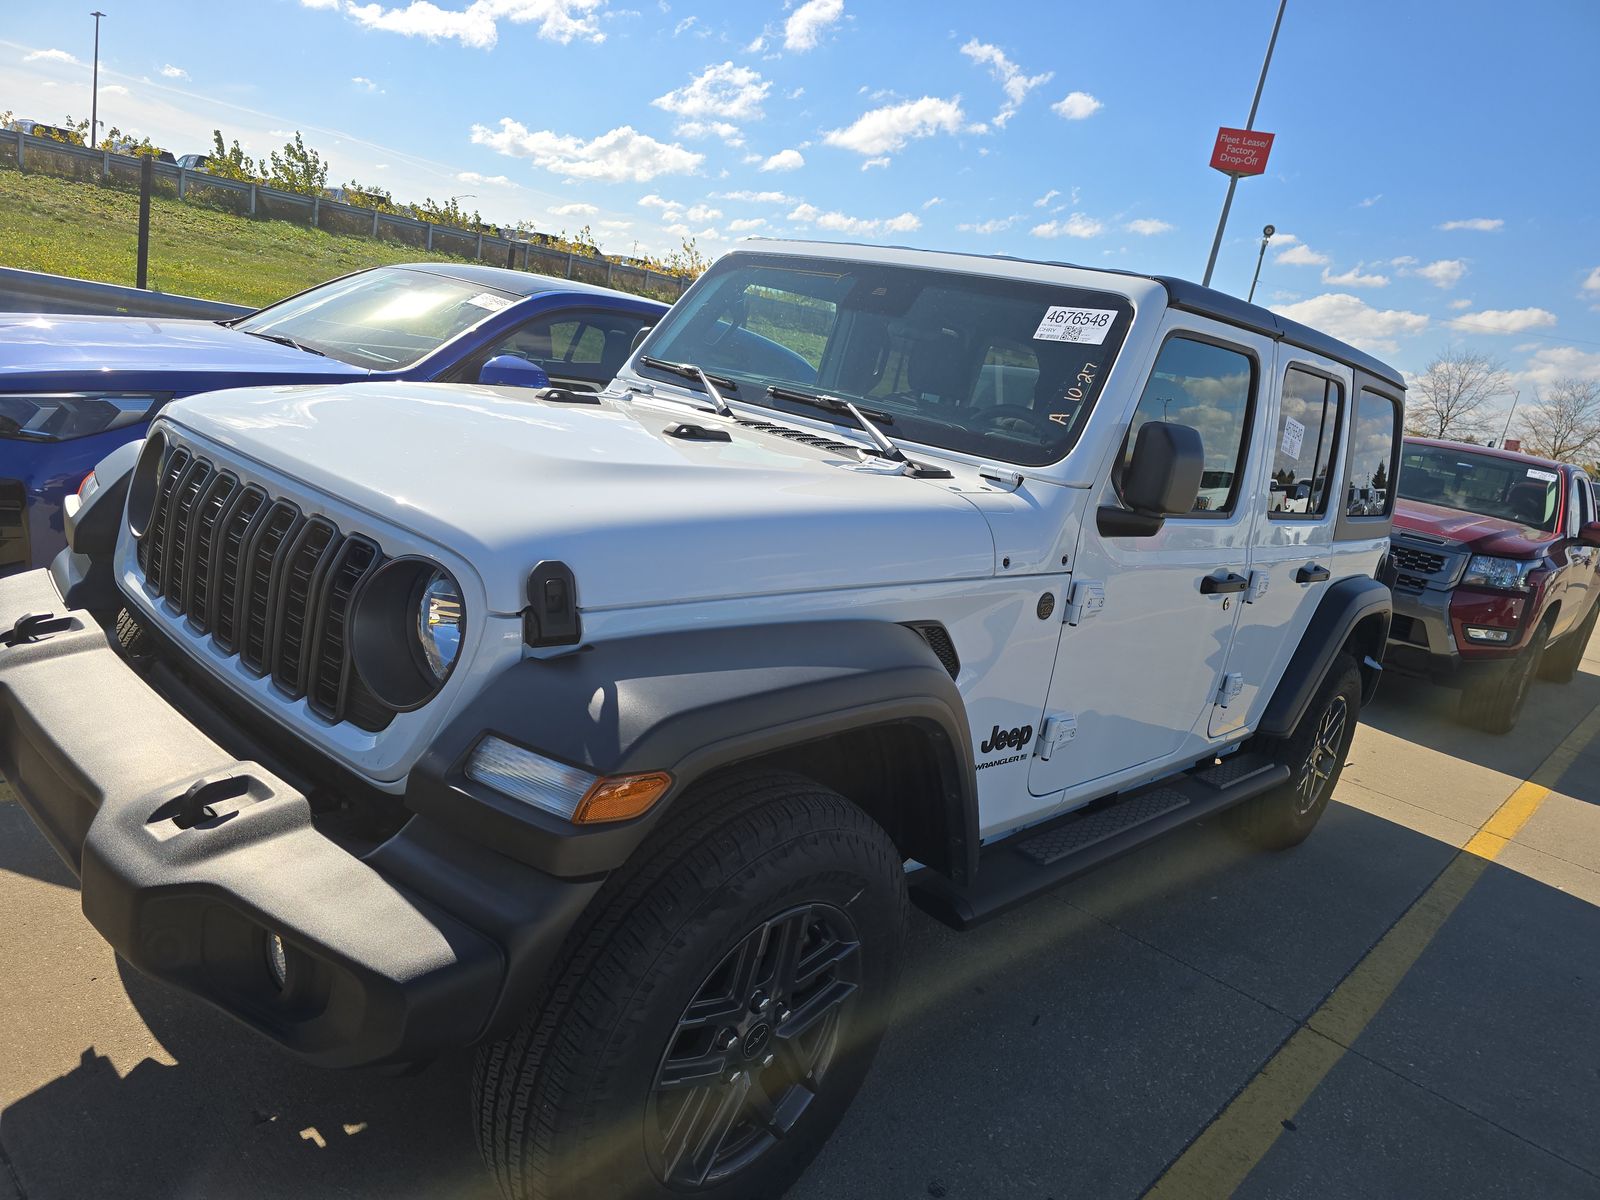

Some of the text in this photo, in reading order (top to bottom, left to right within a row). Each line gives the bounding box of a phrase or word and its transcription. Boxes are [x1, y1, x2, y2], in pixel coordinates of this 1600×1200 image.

[1219, 134, 1269, 148] Fleet Lease/
[1226, 144, 1257, 157] Factory
[1219, 153, 1258, 166] Drop-Off
[1047, 310, 1110, 327] 4676548
[1049, 413, 1070, 425] A
[1063, 362, 1098, 401] 10-27
[980, 725, 1033, 754] Jeep
[974, 755, 1019, 771] WRANGLER
